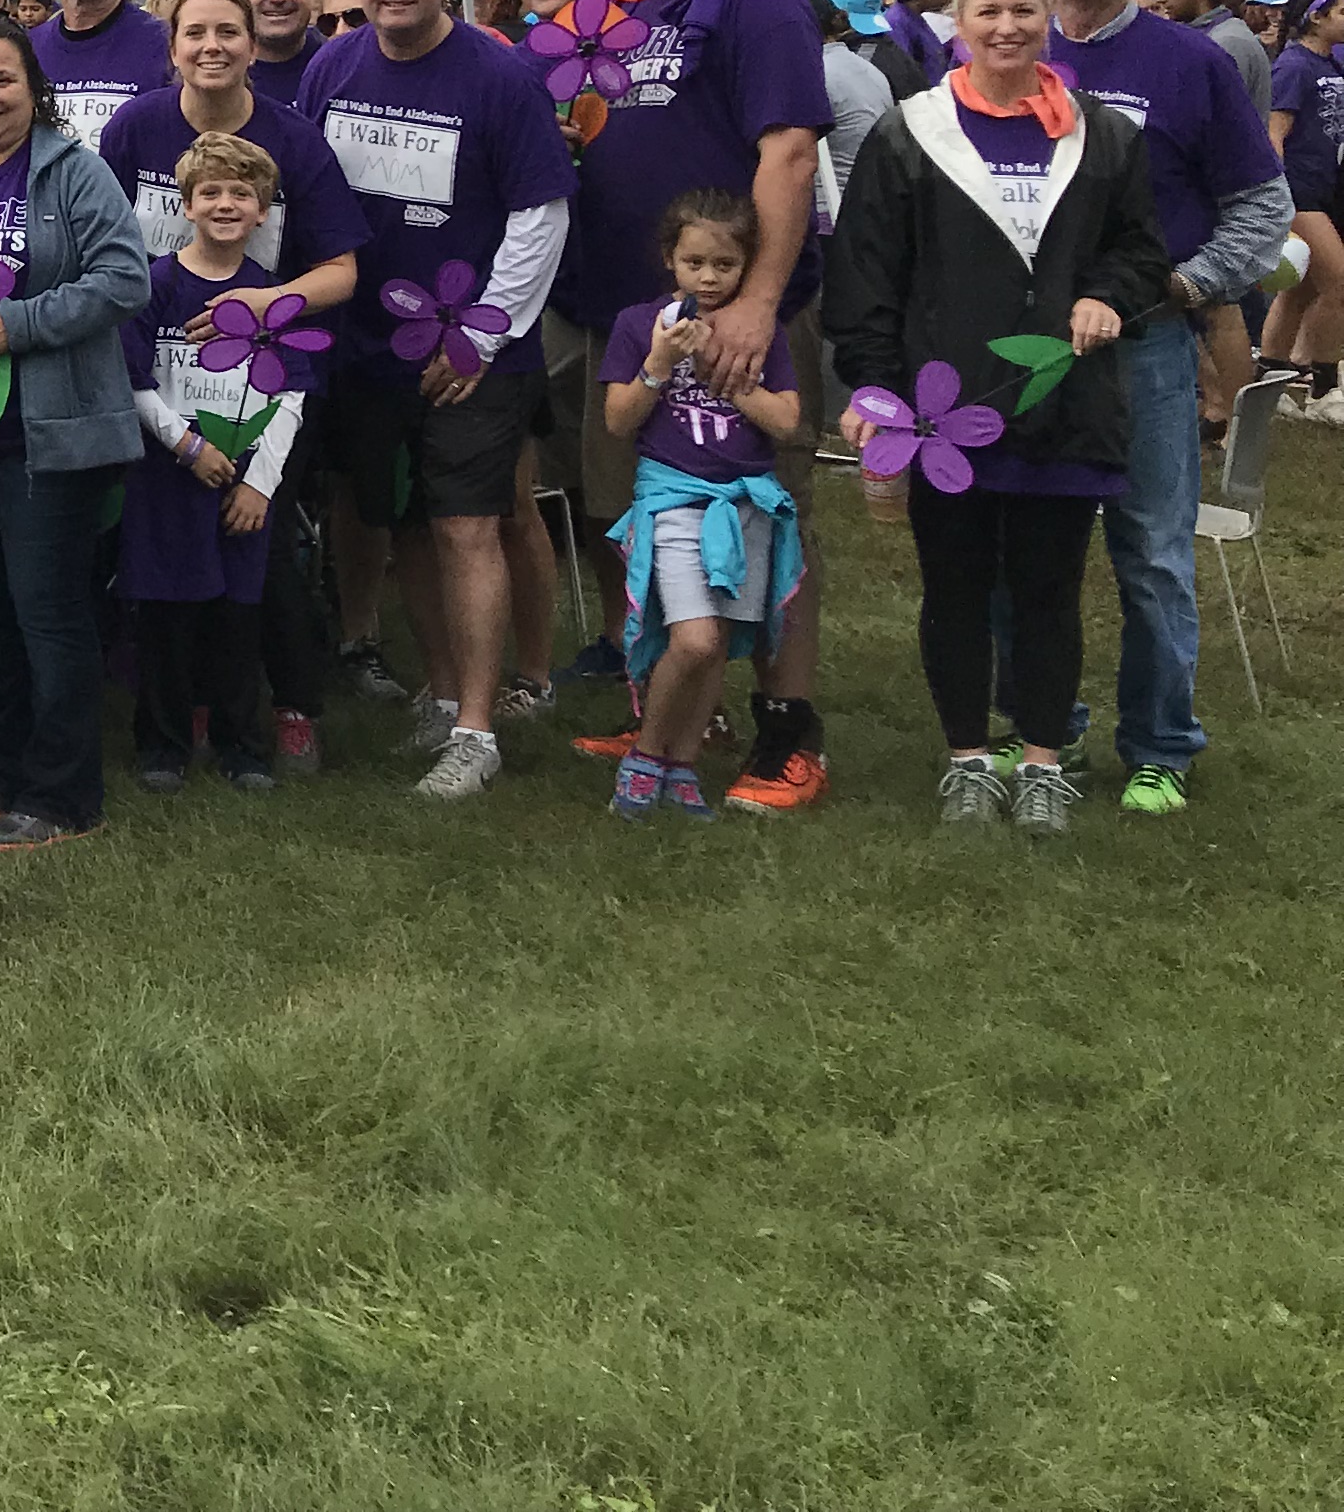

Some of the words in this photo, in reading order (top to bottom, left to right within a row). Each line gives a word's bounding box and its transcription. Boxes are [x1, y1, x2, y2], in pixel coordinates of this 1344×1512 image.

[55, 82, 65, 91] to
[66, 80, 83, 91] End
[83, 79, 139, 92] Alzheimer's
[83, 98, 118, 117] For
[349, 100, 372, 115] Walk
[372, 105, 384, 115] to
[385, 105, 404, 118] End
[404, 108, 463, 126] Alzheimer's
[335, 120, 344, 139] I
[350, 122, 399, 147] Walk
[403, 130, 440, 154] For
[137, 169, 157, 183] 2018
[1000, 163, 1014, 173] to
[1016, 162, 1042, 173] End
[1001, 182, 1042, 204] alk
[168, 348, 200, 368] Wa
